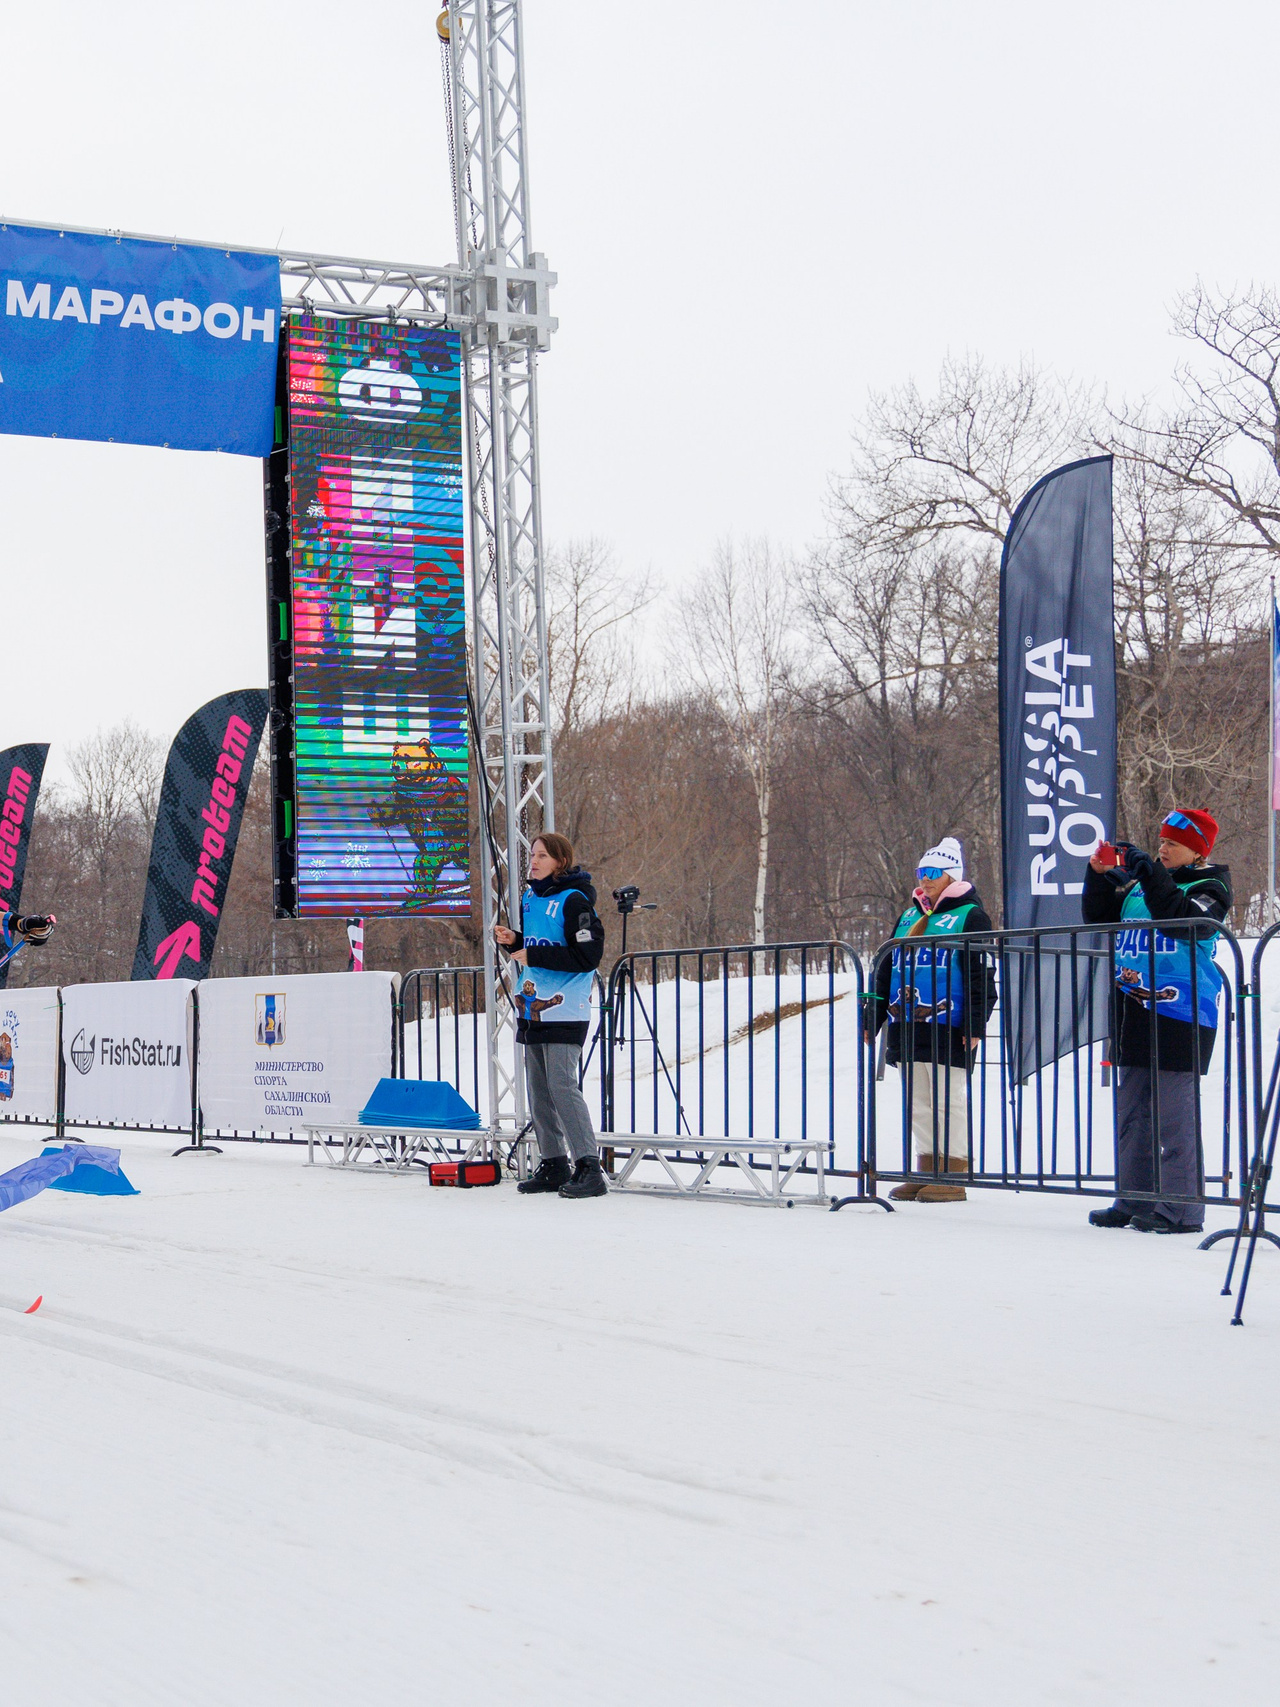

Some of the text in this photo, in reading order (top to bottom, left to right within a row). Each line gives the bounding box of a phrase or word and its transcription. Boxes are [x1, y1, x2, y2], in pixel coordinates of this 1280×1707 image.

[6, 282, 276, 343] МАРАФОН
[191, 714, 253, 917] proteam
[545, 899, 560, 919] 11
[934, 913, 959, 930] 21
[101, 1037, 182, 1067] FishStat.ru
[254, 1061, 324, 1073] МИНИСТЕРСТВО
[253, 1075, 288, 1086] СПОРТА
[264, 1090, 332, 1103] САХАЛИНСКОЙ
[264, 1104, 304, 1117] ОБЛАСТИ
